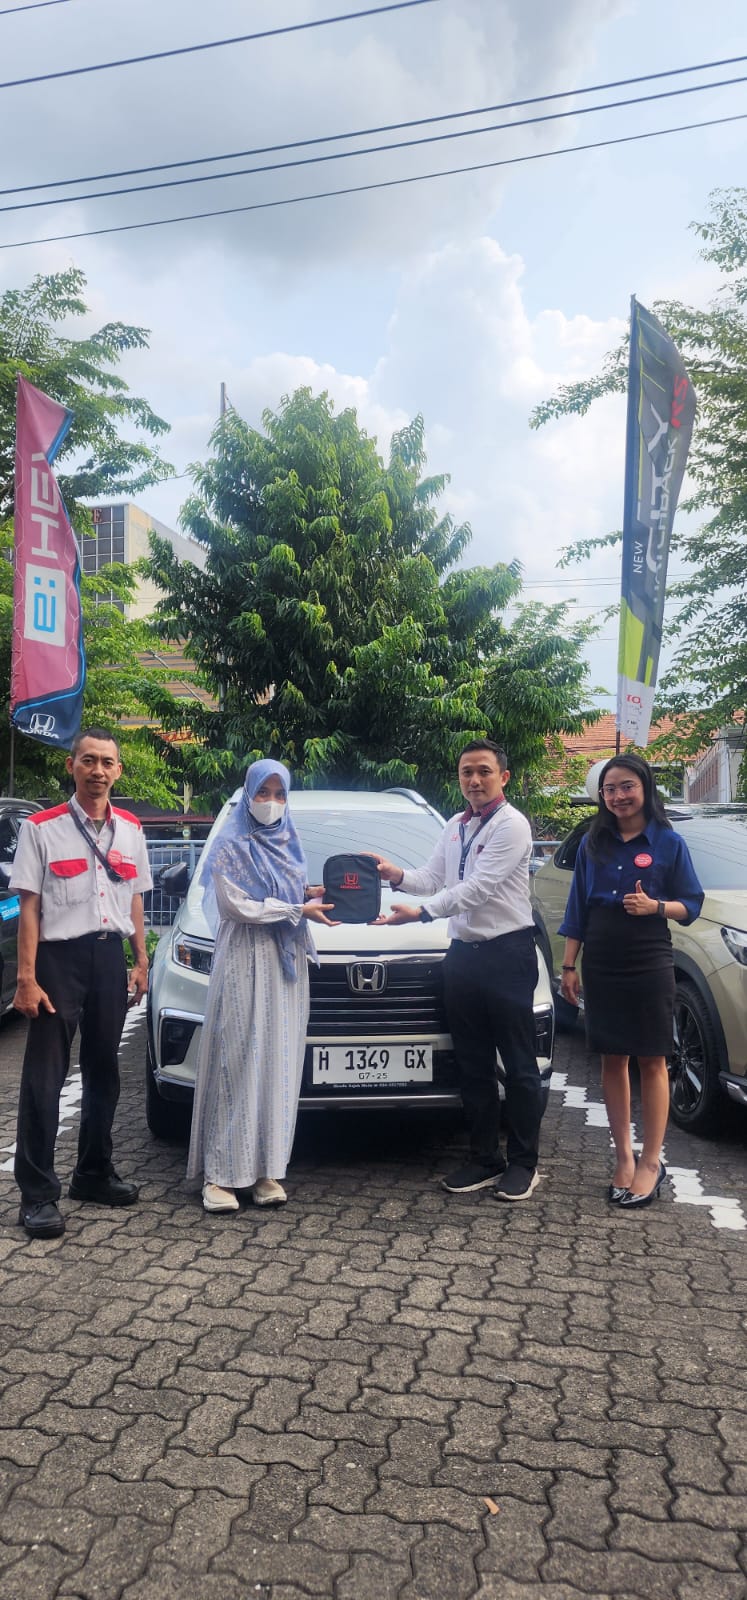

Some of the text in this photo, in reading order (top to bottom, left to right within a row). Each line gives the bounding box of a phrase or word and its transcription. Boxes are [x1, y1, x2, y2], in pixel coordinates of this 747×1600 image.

[632, 541, 645, 574] NEW
[318, 1049, 427, 1071] H 1349 GX
